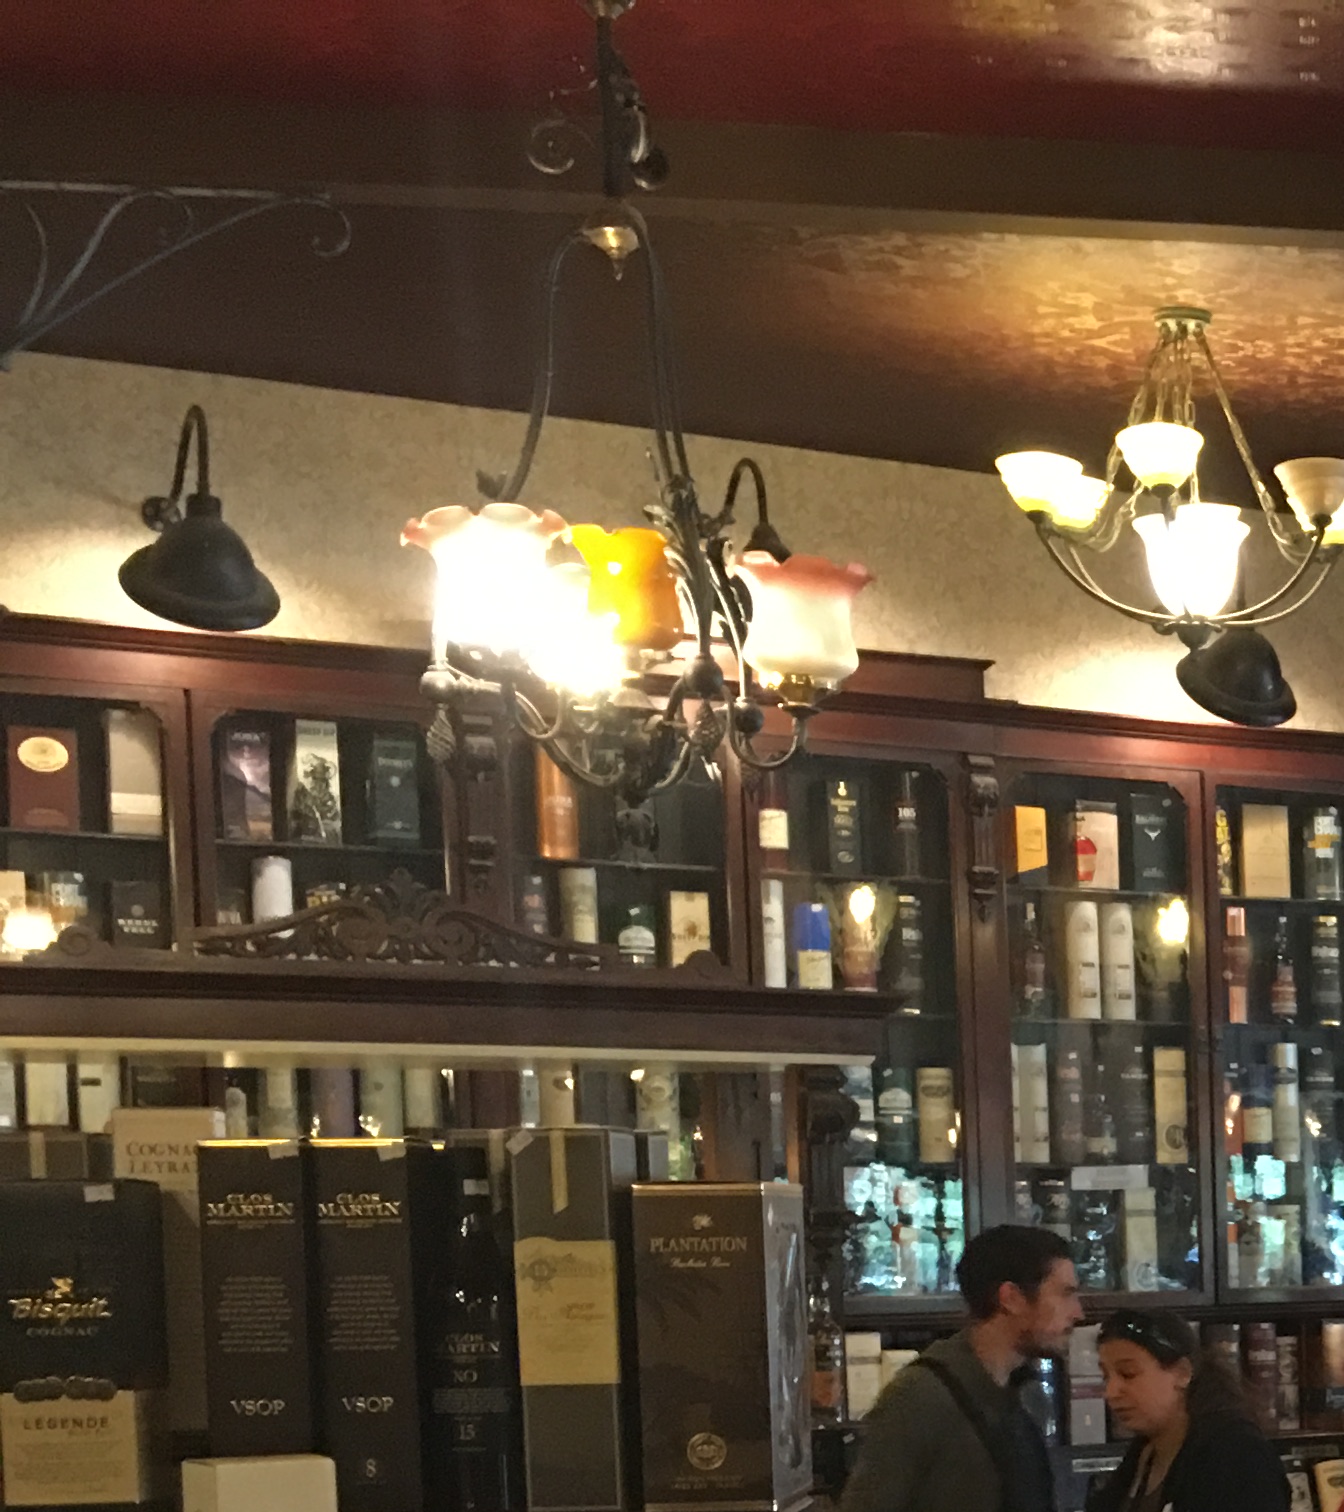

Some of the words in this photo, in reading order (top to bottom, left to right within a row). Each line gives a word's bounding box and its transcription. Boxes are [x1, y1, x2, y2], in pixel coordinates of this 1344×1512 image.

[129, 1160, 198, 1174] LEYRA
[226, 1193, 273, 1204] CLOS
[336, 1193, 380, 1203] CLOS
[207, 1203, 295, 1217] MARTIN
[318, 1202, 401, 1216] MARTIN
[650, 1236, 748, 1252] PLANTATION
[7, 1297, 112, 1326] Bisquit
[26, 1327, 99, 1338] COGNAC
[230, 1400, 286, 1416] VSOP
[342, 1397, 395, 1413] VSOP
